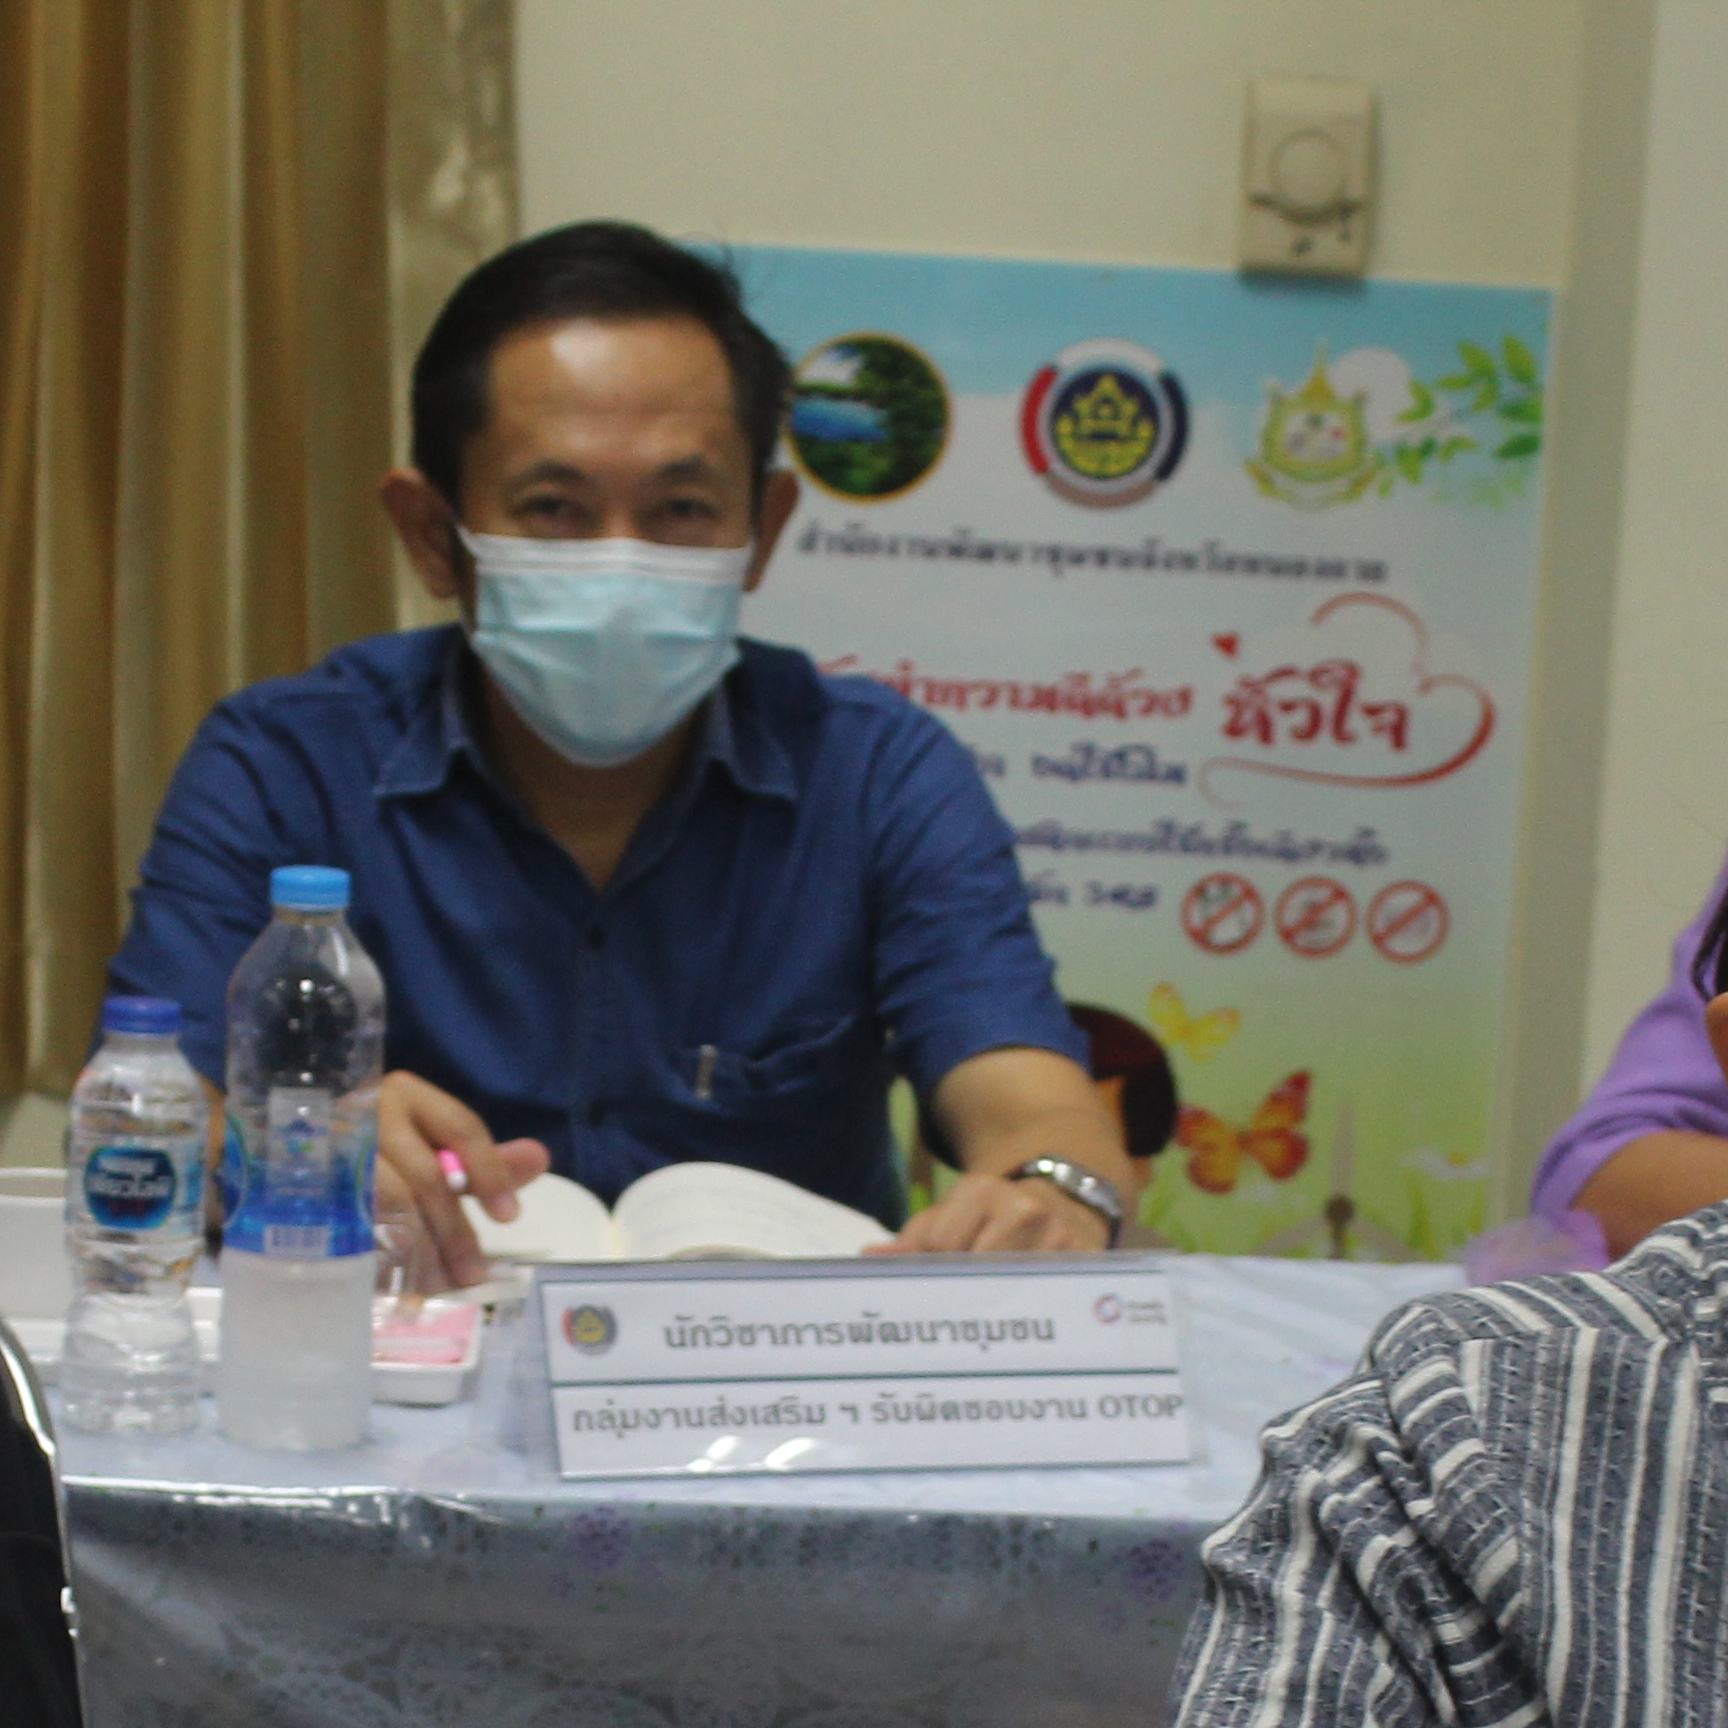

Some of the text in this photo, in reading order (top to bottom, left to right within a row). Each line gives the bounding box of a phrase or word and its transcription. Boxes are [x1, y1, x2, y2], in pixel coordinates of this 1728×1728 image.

[1221, 660, 1411, 752] หัวใจ
[661, 1308, 1057, 1353] นักวิชาการพัฒนาชุมชน
[571, 1395, 827, 1440] กลุ่มงานส่งเสริม
[870, 1389, 1090, 1426] รับผิดชอบงาน
[1097, 1390, 1186, 1419] OTOP
